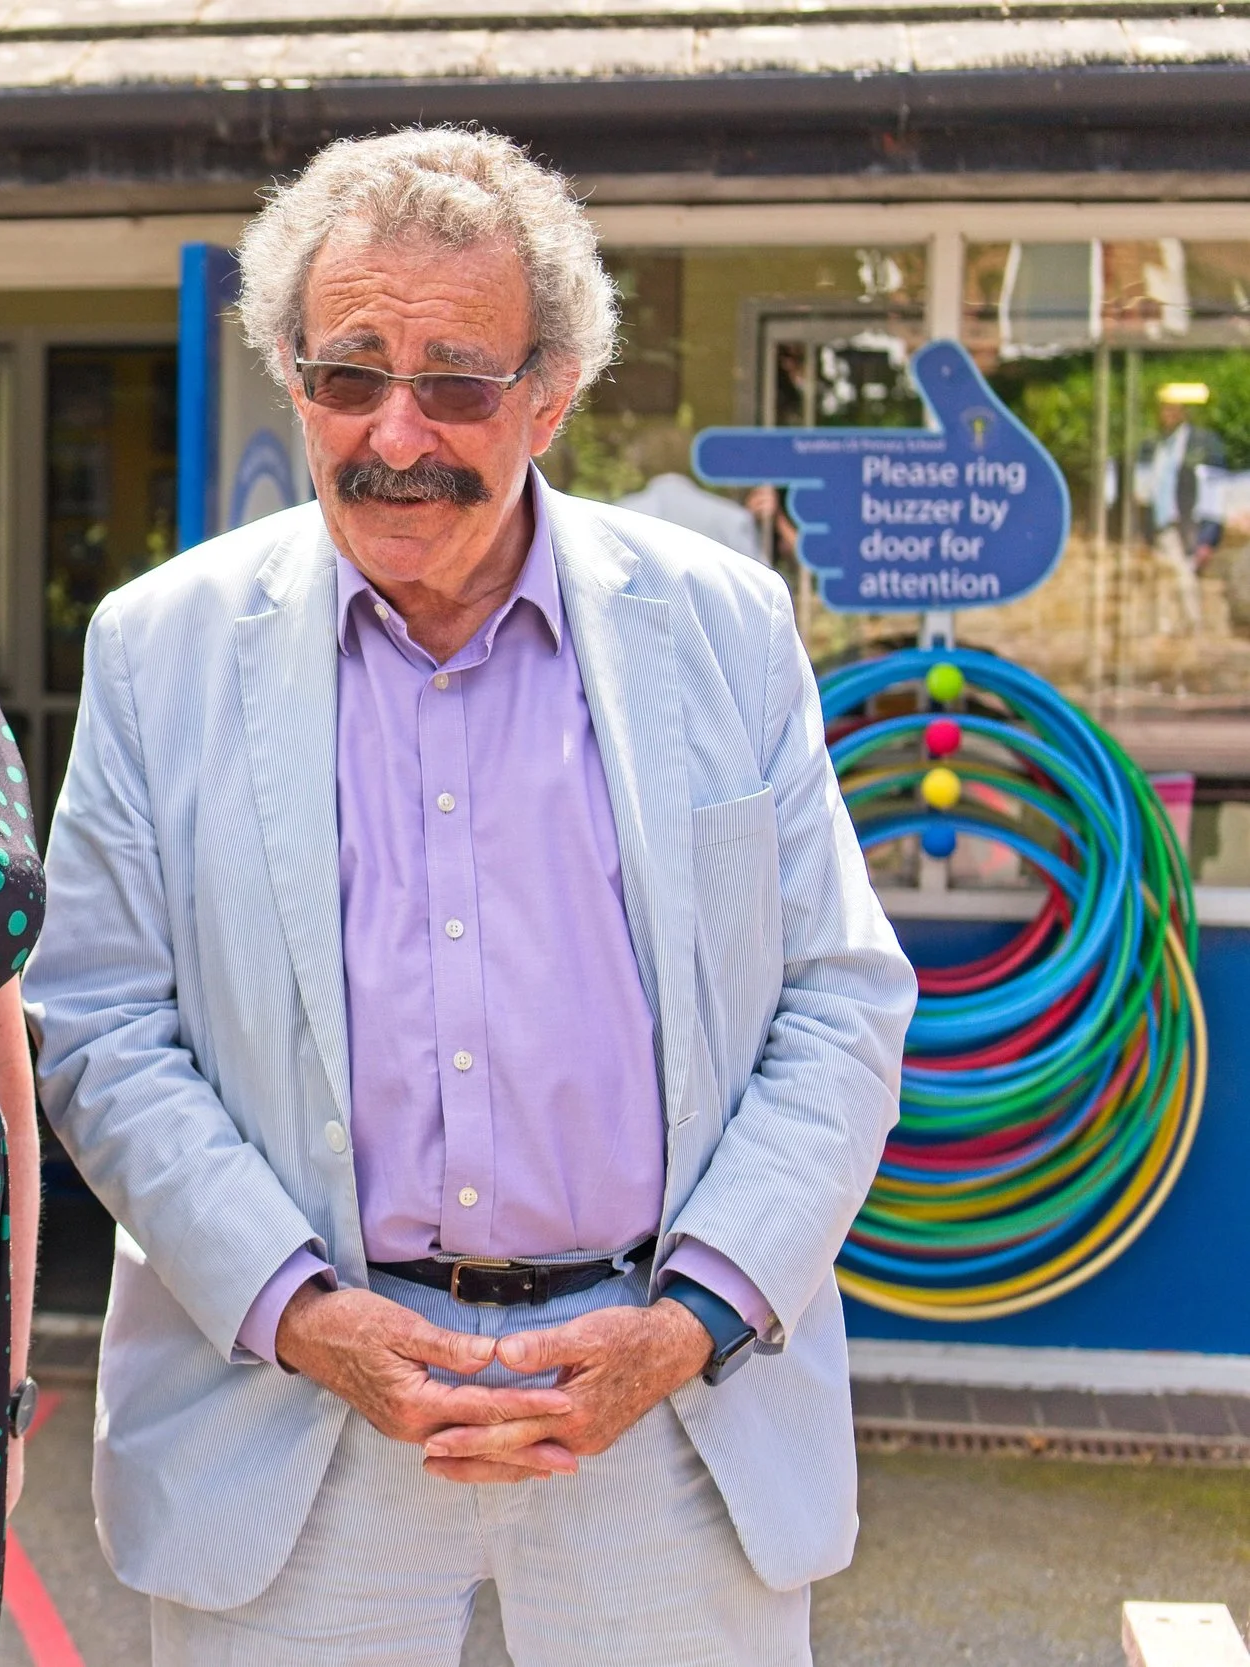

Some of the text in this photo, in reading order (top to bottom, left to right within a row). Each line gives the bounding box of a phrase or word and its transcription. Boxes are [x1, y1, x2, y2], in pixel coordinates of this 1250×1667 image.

[862, 456, 1027, 494] Please ring
[861, 492, 1010, 531] buzzer by
[859, 530, 984, 562] door for
[859, 568, 1000, 599] attention
